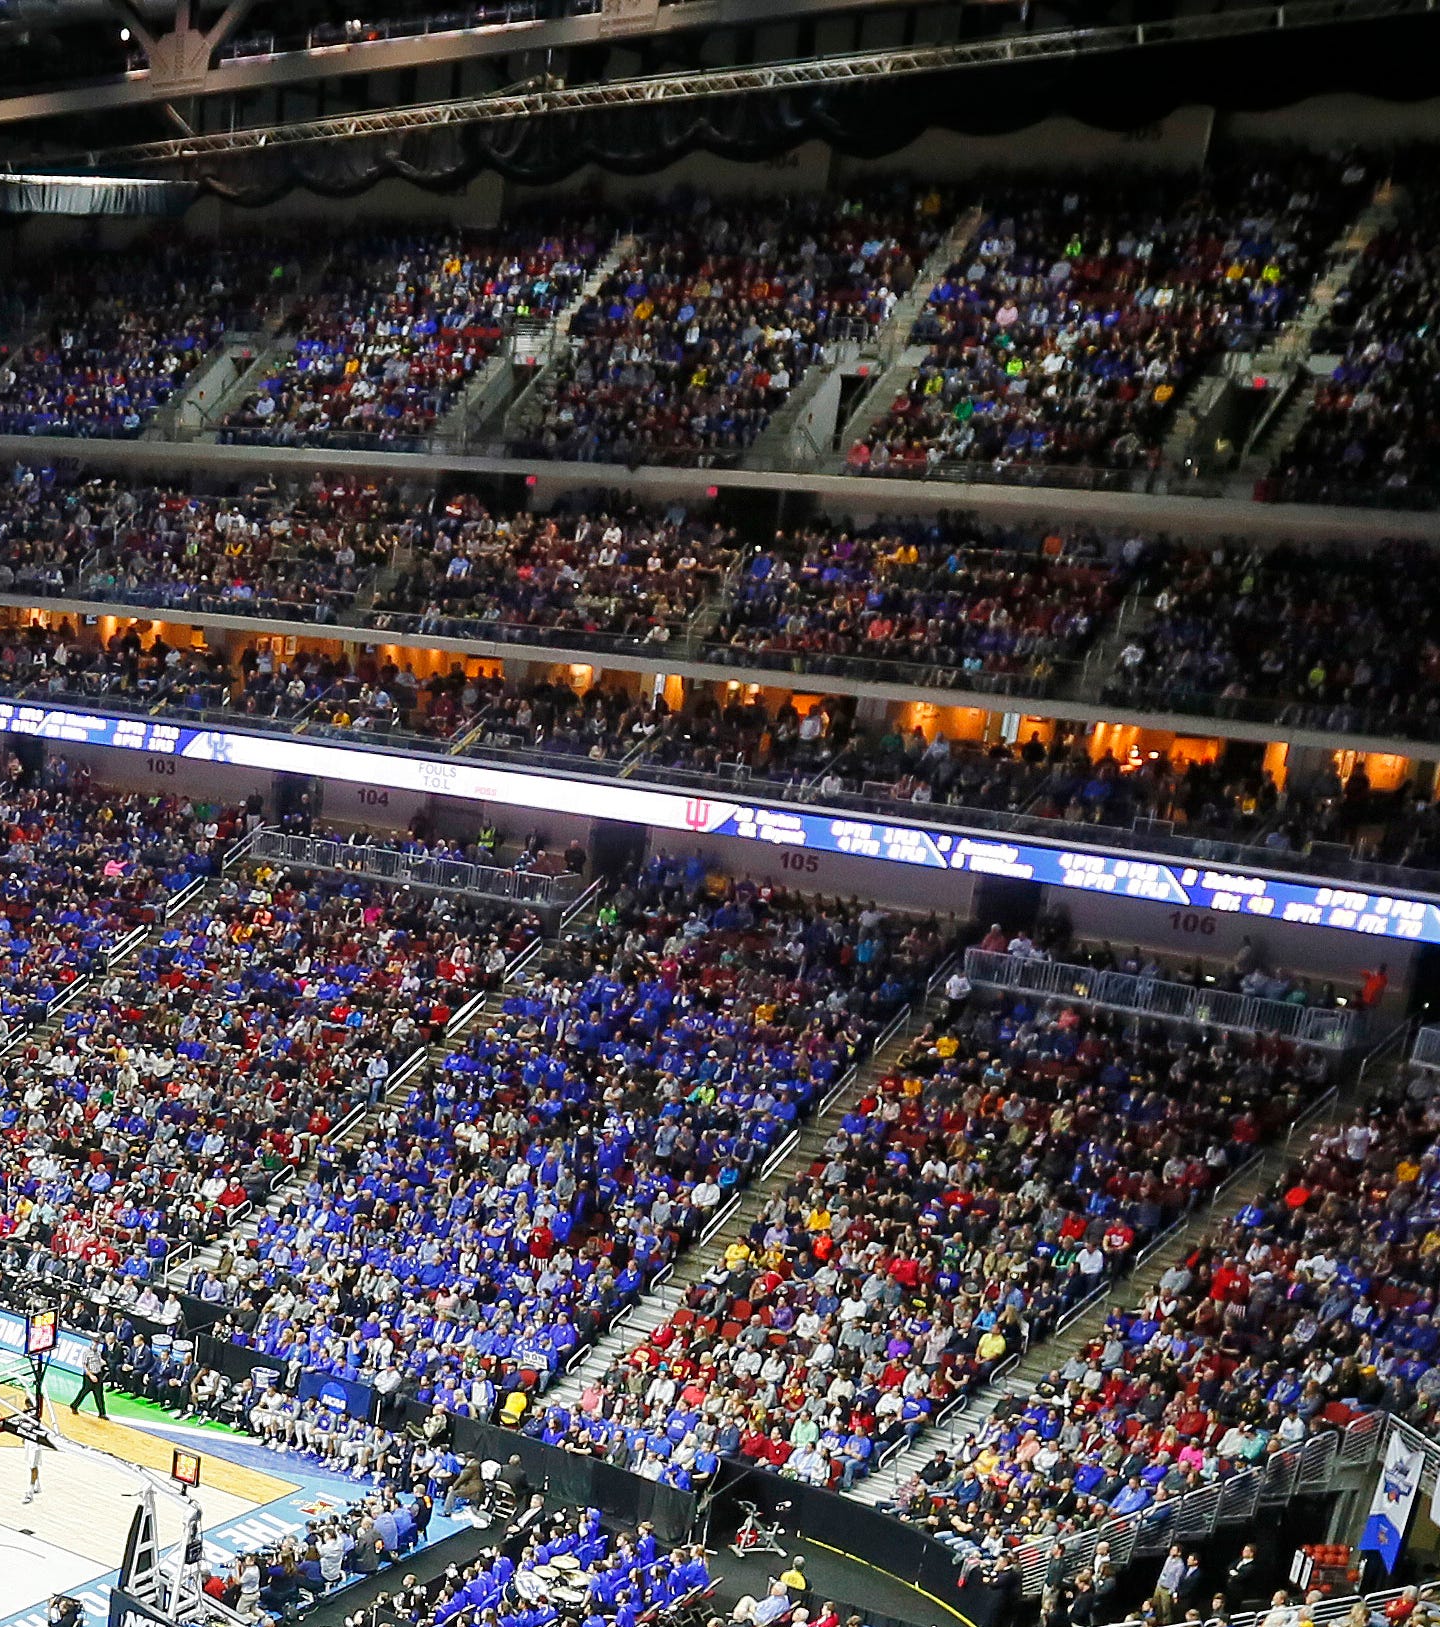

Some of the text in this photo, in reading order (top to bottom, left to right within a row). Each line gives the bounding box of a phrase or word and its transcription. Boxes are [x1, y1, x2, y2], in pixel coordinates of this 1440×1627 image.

[147, 758, 176, 775] 103
[419, 763, 456, 778] FOULS
[357, 788, 389, 807] 104
[780, 851, 818, 872] 105
[1170, 912, 1216, 935] 106
[322, 1393, 346, 1411] NCAA
